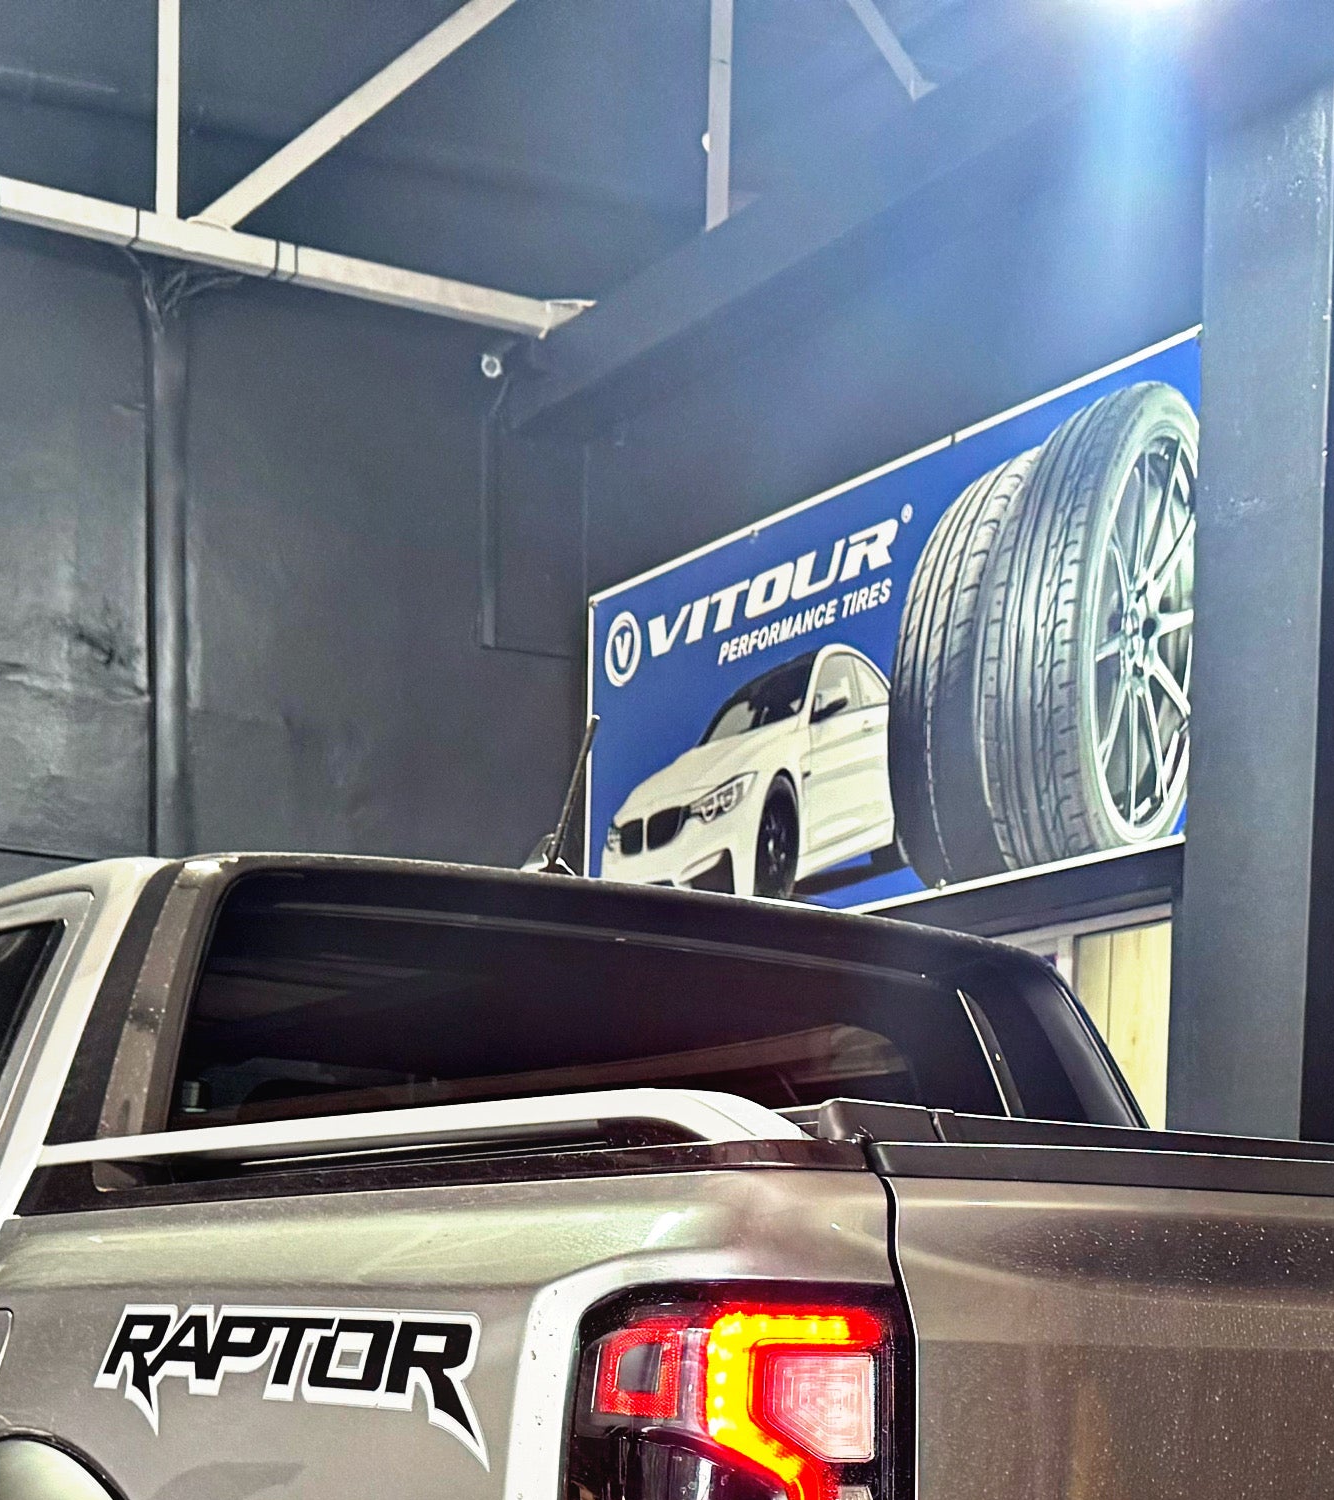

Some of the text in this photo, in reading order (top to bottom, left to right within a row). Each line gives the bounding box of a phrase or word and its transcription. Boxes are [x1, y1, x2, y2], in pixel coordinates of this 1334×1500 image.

[647, 518, 899, 658] VITOUR
[717, 578, 893, 666] PERFORMANCE TIRES
[94, 1303, 491, 1473] RAPTOR
